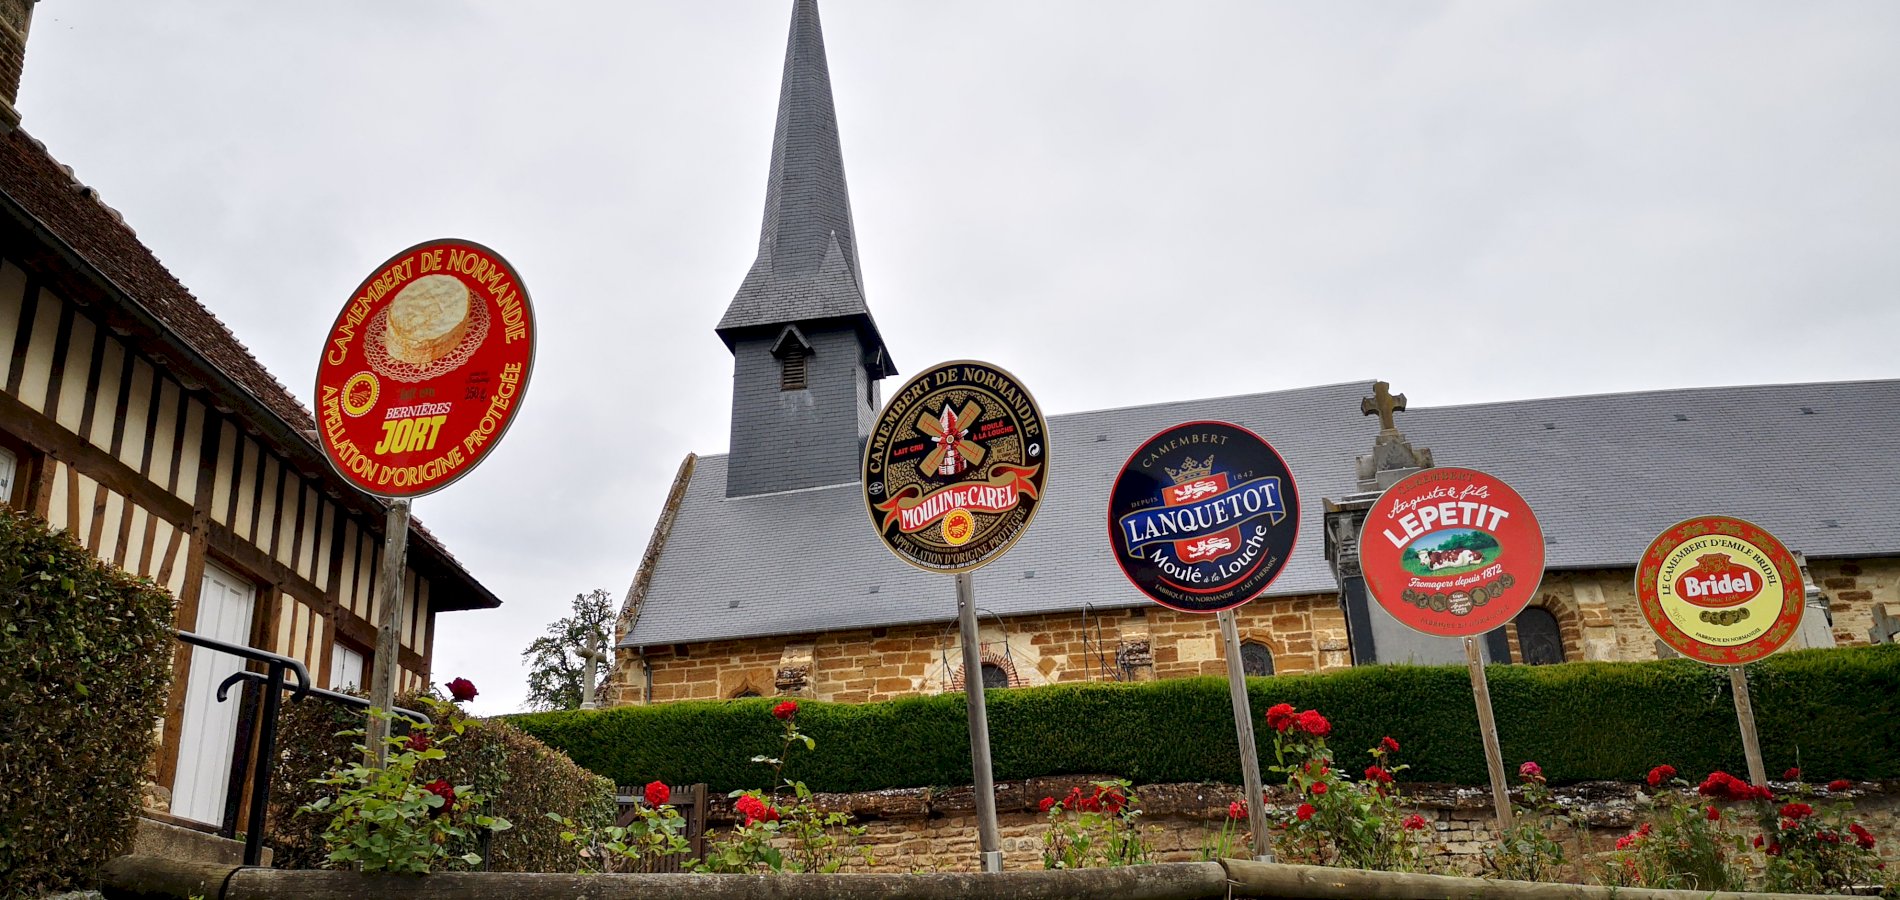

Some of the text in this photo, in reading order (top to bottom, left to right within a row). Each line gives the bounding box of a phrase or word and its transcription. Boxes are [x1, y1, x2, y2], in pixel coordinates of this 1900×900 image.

[328, 249, 526, 366] CAMEMBERT DE NORMANDIE
[322, 362, 522, 487] APPELLATION D'ORIGINE PROTÉGÉE
[375, 415, 447, 455] JORT
[870, 367, 1040, 474] CAMEMBERT DE NORMANDIE
[988, 425, 1014, 437] LOUCHE
[893, 443, 924, 456] LAIT CRU
[1142, 433, 1229, 468] CAMEMBERT
[1233, 470, 1254, 481] 1842
[901, 489, 955, 530] MOULIN
[954, 492, 967, 508] DE
[967, 484, 1017, 510] CAREL
[1127, 483, 1276, 543] LANQUETOT
[1130, 496, 1159, 508] DEPUIS
[1387, 484, 1491, 519] Auguste & fils
[1383, 501, 1510, 549] LEPETIT
[892, 533, 942, 564] APPELLATION
[944, 542, 990, 565] D'ORIGINE
[1150, 548, 1202, 584] Moulé
[1219, 524, 1267, 580] Louche
[1408, 563, 1502, 591] Fromagers depuis 1872
[1662, 539, 1777, 595] LE CAMEMBERT D'EMILE BRIDEL
[1684, 571, 1754, 597] Bridel
[1195, 591, 1234, 603] NORMANDIE
[1240, 580, 1254, 592] LAIT
[1730, 627, 1762, 642] NORMANDIE
